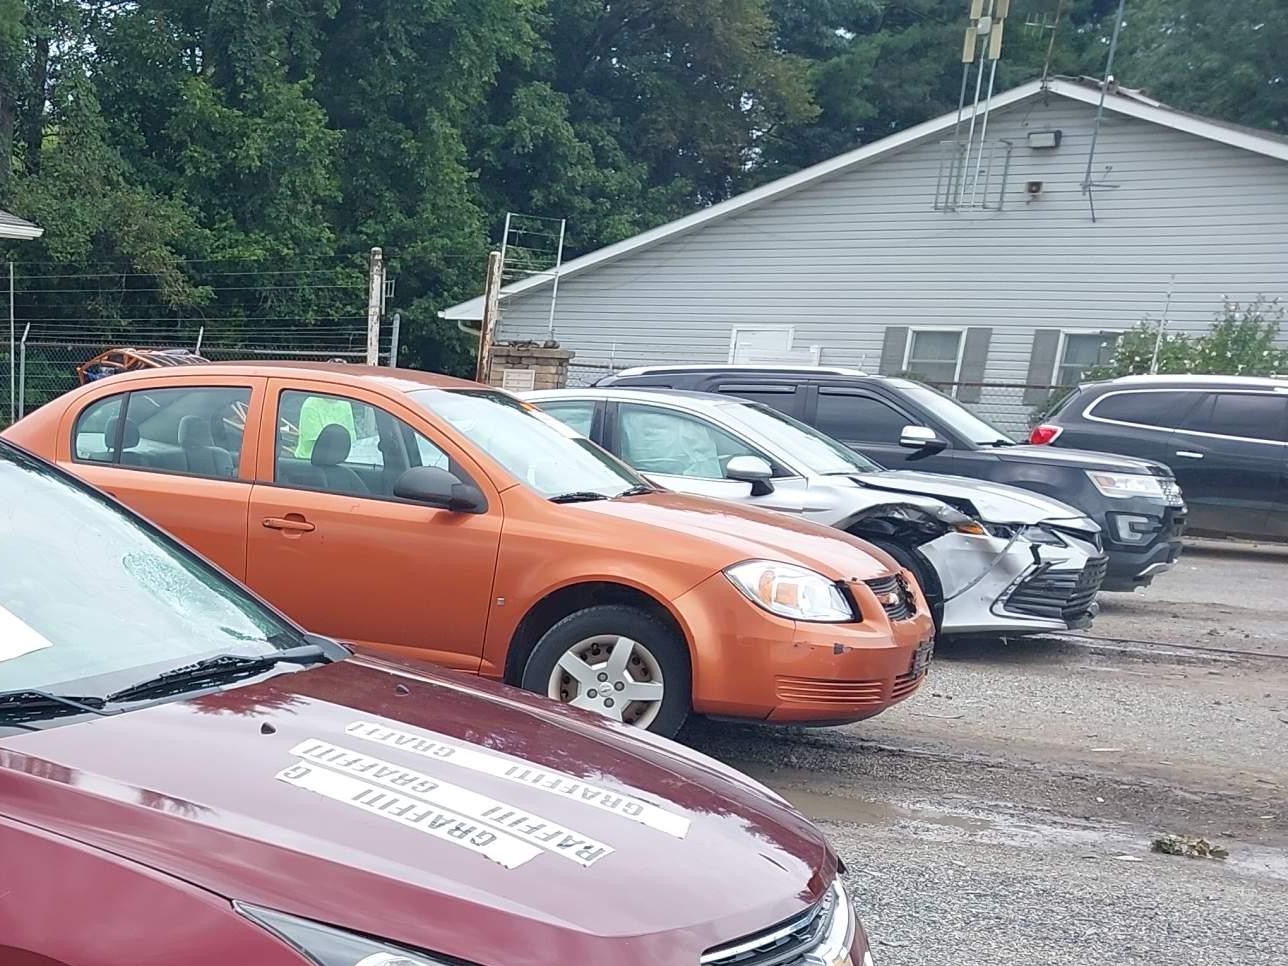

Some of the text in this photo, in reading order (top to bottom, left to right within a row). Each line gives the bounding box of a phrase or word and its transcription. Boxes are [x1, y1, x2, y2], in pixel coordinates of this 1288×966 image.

[282, 765, 498, 847] GRAFFITI G
[302, 744, 606, 862] RAFFITI GRAFFITI
[504, 766, 645, 816] GRAFFITI
